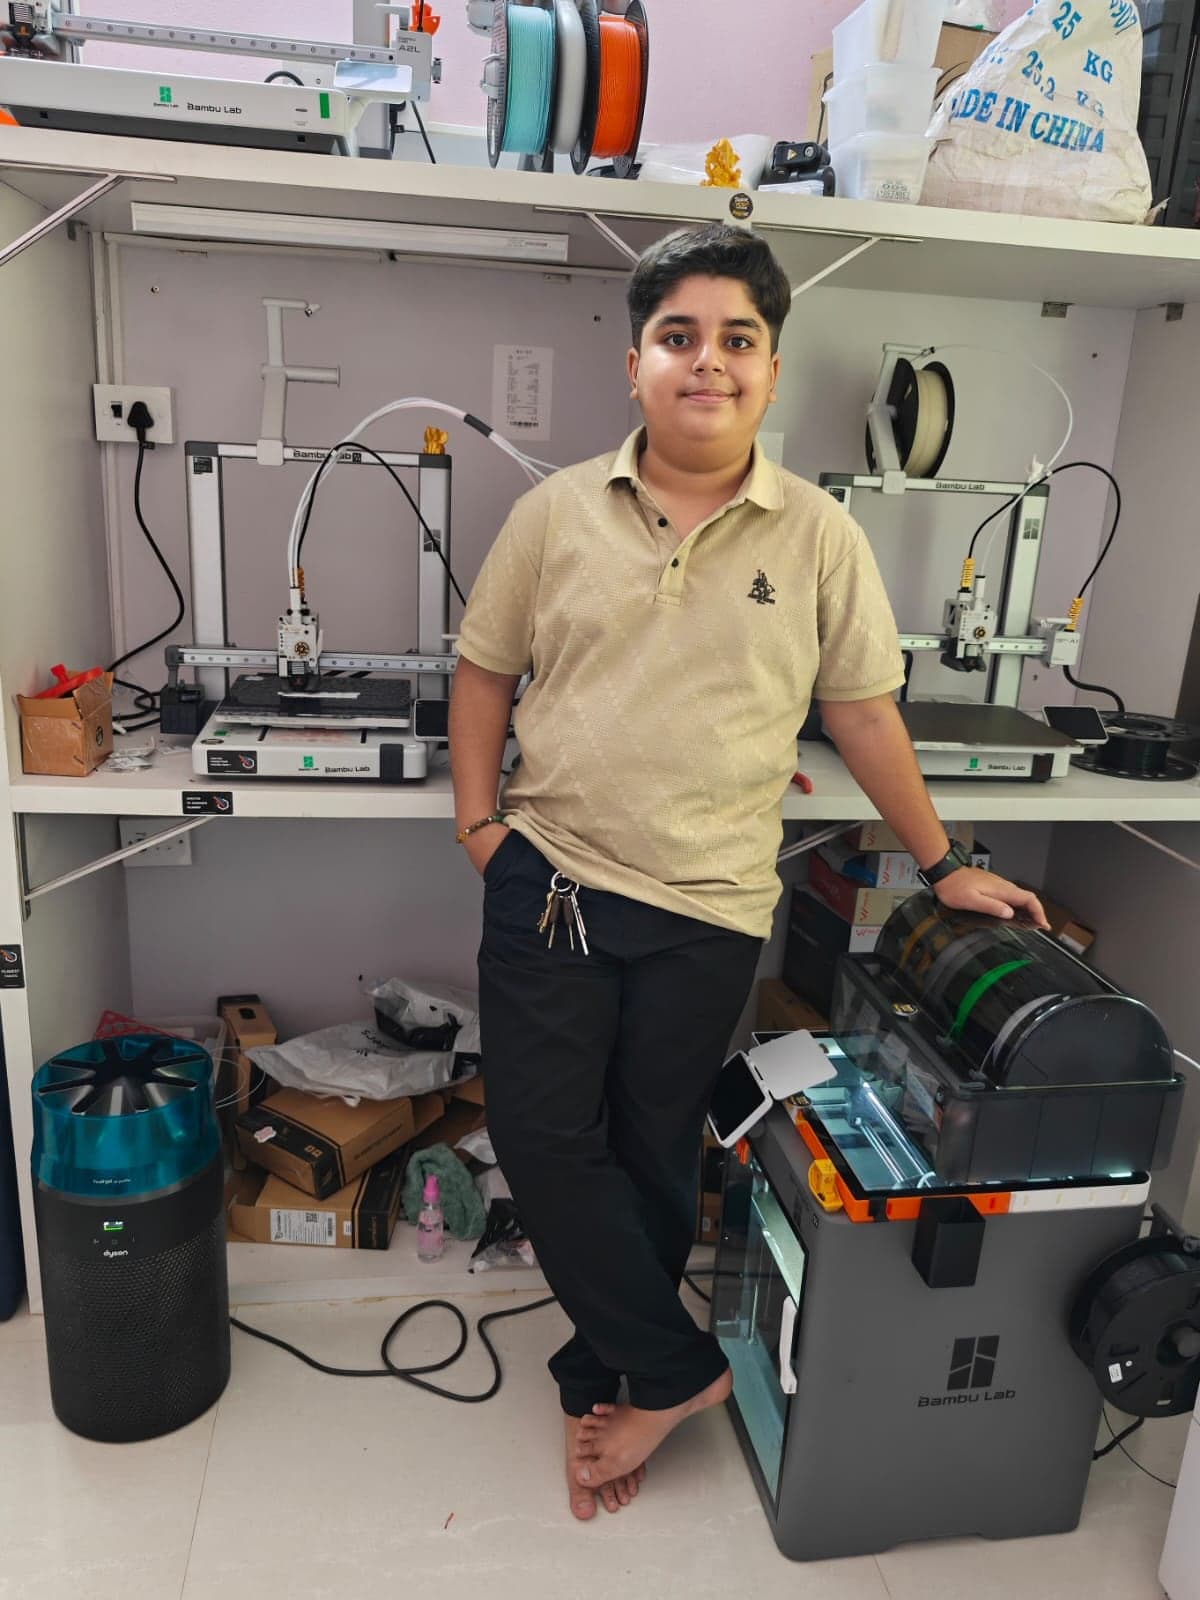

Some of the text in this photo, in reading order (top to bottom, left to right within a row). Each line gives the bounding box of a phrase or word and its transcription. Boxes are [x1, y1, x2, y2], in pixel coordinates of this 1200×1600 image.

[1051, 1, 1083, 41] 25
[1083, 49, 1113, 84] KG
[186, 102, 221, 113] Bambu
[223, 104, 242, 114] Lab
[995, 97, 1031, 133] IN
[1030, 111, 1105, 153] CHINA
[103, 1248, 129, 1258] dyson
[917, 1388, 1016, 1408] Bambu Lab
